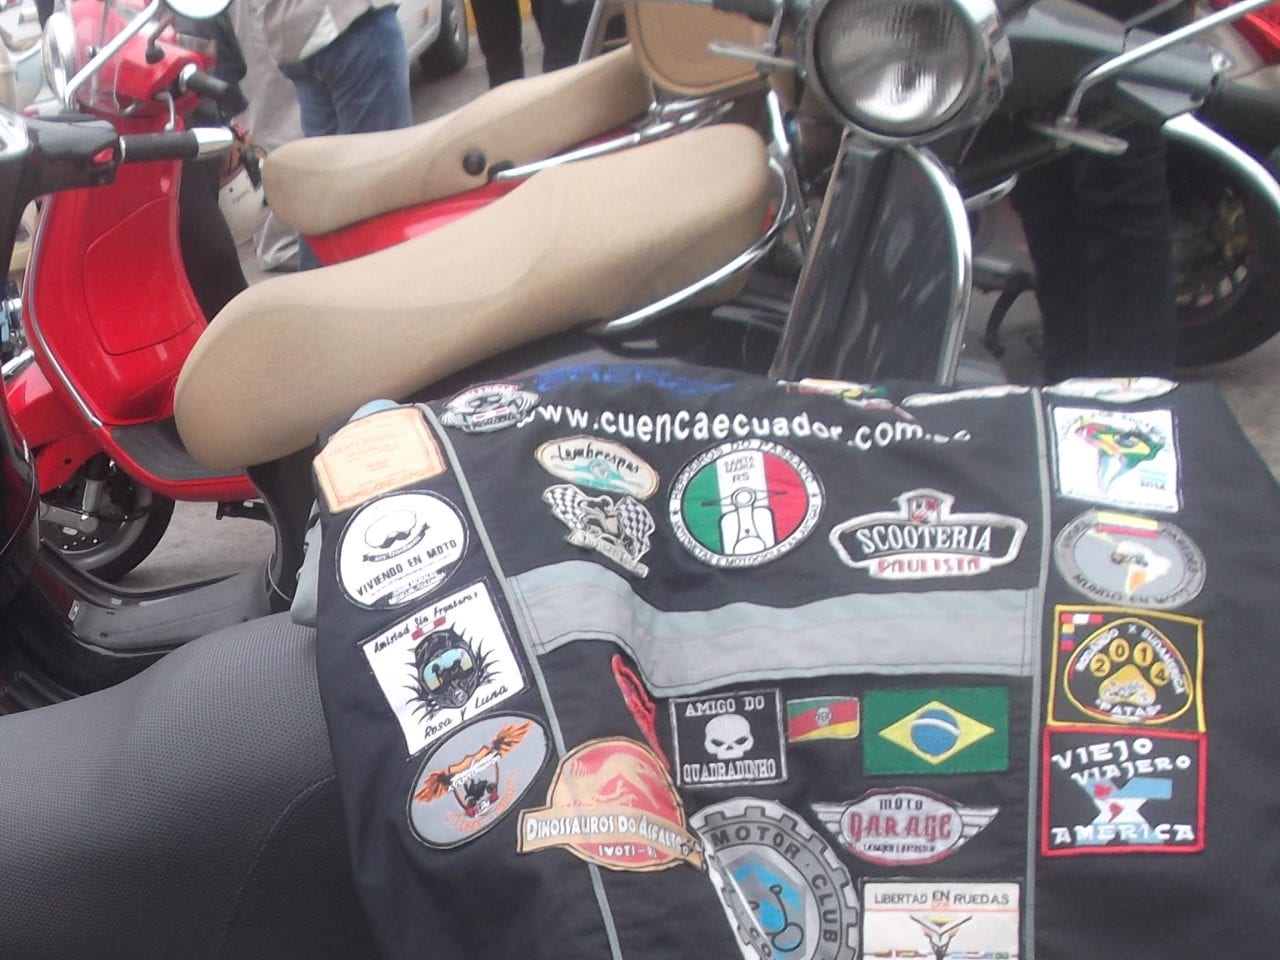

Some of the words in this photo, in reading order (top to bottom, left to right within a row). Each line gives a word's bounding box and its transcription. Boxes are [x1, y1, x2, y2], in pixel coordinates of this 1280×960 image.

[855, 525, 992, 555] SCOOTERIA
[356, 563, 404, 597] VIVIENDO
[407, 554, 423, 567] EN
[877, 556, 982, 574] PAULISTA
[475, 686, 509, 709] Luna
[684, 698, 736, 717] AMIGO
[743, 695, 766, 712] DO
[1051, 736, 1154, 770] VIEJO
[683, 758, 777, 783] QUADRADINHO
[1070, 754, 1192, 787] VIAJERO
[879, 798, 924, 811] MOTO
[526, 815, 614, 841] DINOSSAUROS
[849, 811, 954, 841] GARAGE
[1051, 823, 1195, 846] AMERICA
[710, 824, 801, 860] MOTOR
[811, 873, 839, 944] CLUB
[874, 893, 929, 905] LIBERTAD
[932, 889, 951, 901] EN
[953, 893, 1010, 906] RUEDAS
